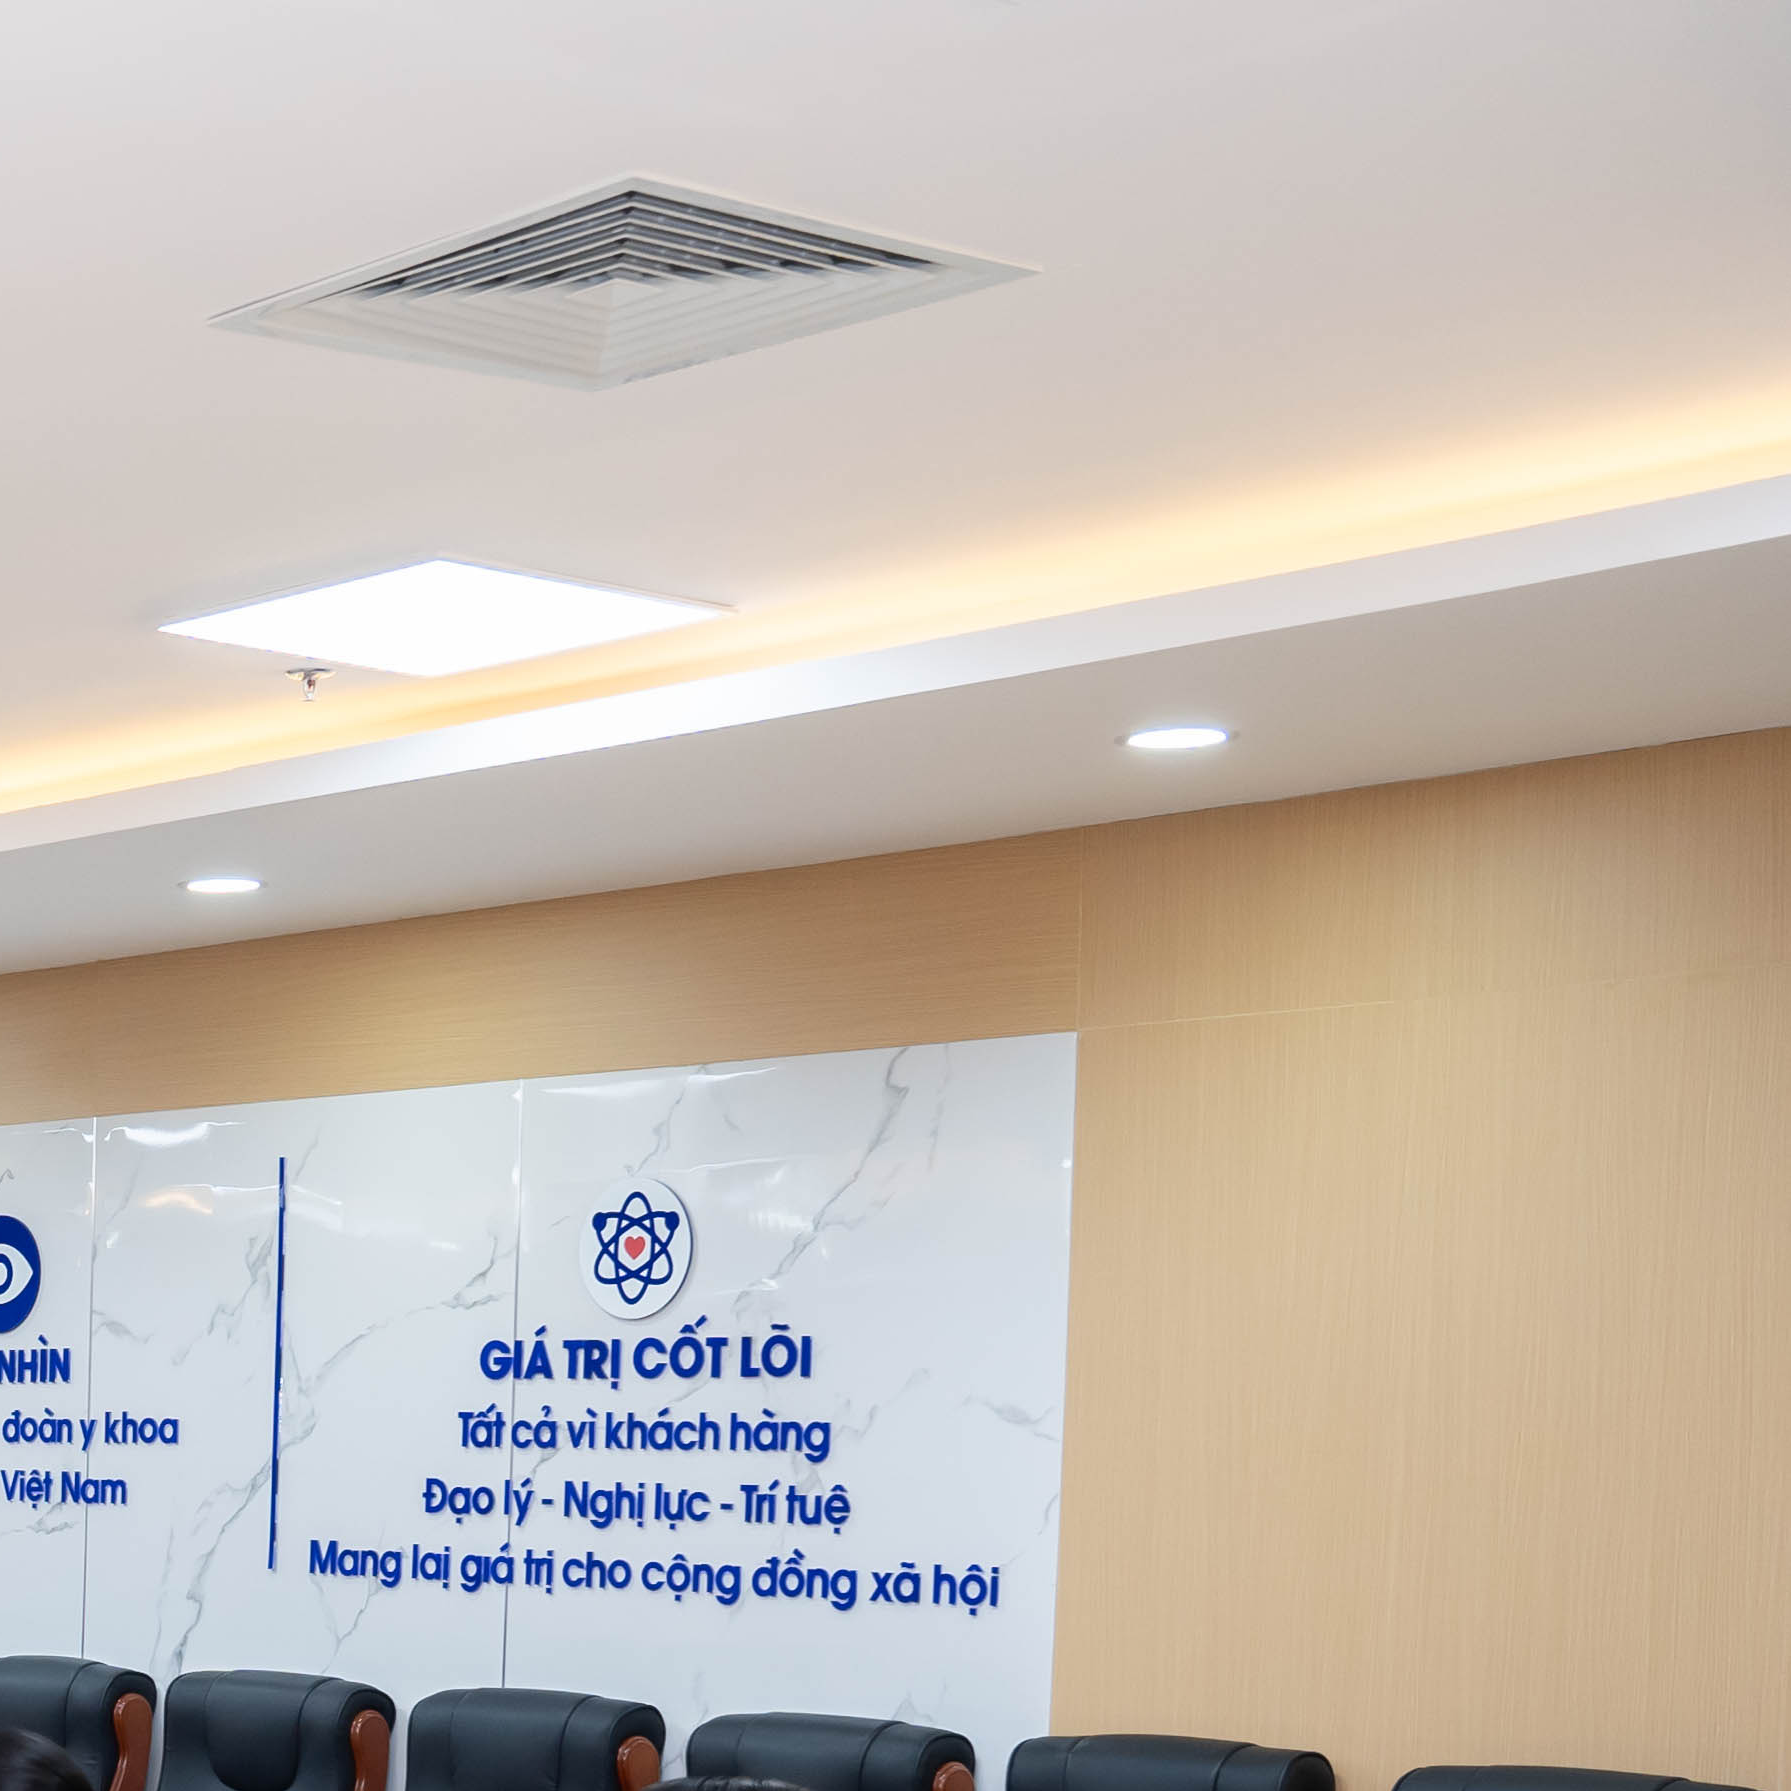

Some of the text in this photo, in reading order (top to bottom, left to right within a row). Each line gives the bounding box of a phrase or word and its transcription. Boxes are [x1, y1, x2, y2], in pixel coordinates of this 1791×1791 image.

[479, 1315, 813, 1390] GIÁ TRỊ CỐT LÕI
[2, 1408, 73, 1444] đoàn
[79, 1419, 97, 1451] y
[104, 1412, 179, 1444] khoa
[458, 1404, 831, 1463] Tất cả vì khách hàng
[0, 1469, 53, 1509] Việt
[61, 1471, 127, 1504] Nam
[422, 1478, 495, 1524] Đạo
[504, 1478, 534, 1526] lý
[563, 1480, 645, 1529] Nghị
[654, 1483, 710, 1530] lực
[740, 1480, 780, 1523] Trí
[786, 1484, 850, 1534] tuệ
[309, 1539, 403, 1589] Mang
[523, 1549, 554, 1595] trị
[562, 1552, 632, 1589] cho
[641, 1554, 742, 1606] cộng
[751, 1549, 858, 1612] đồng
[870, 1562, 922, 1604] xã
[932, 1564, 999, 1616] hội
